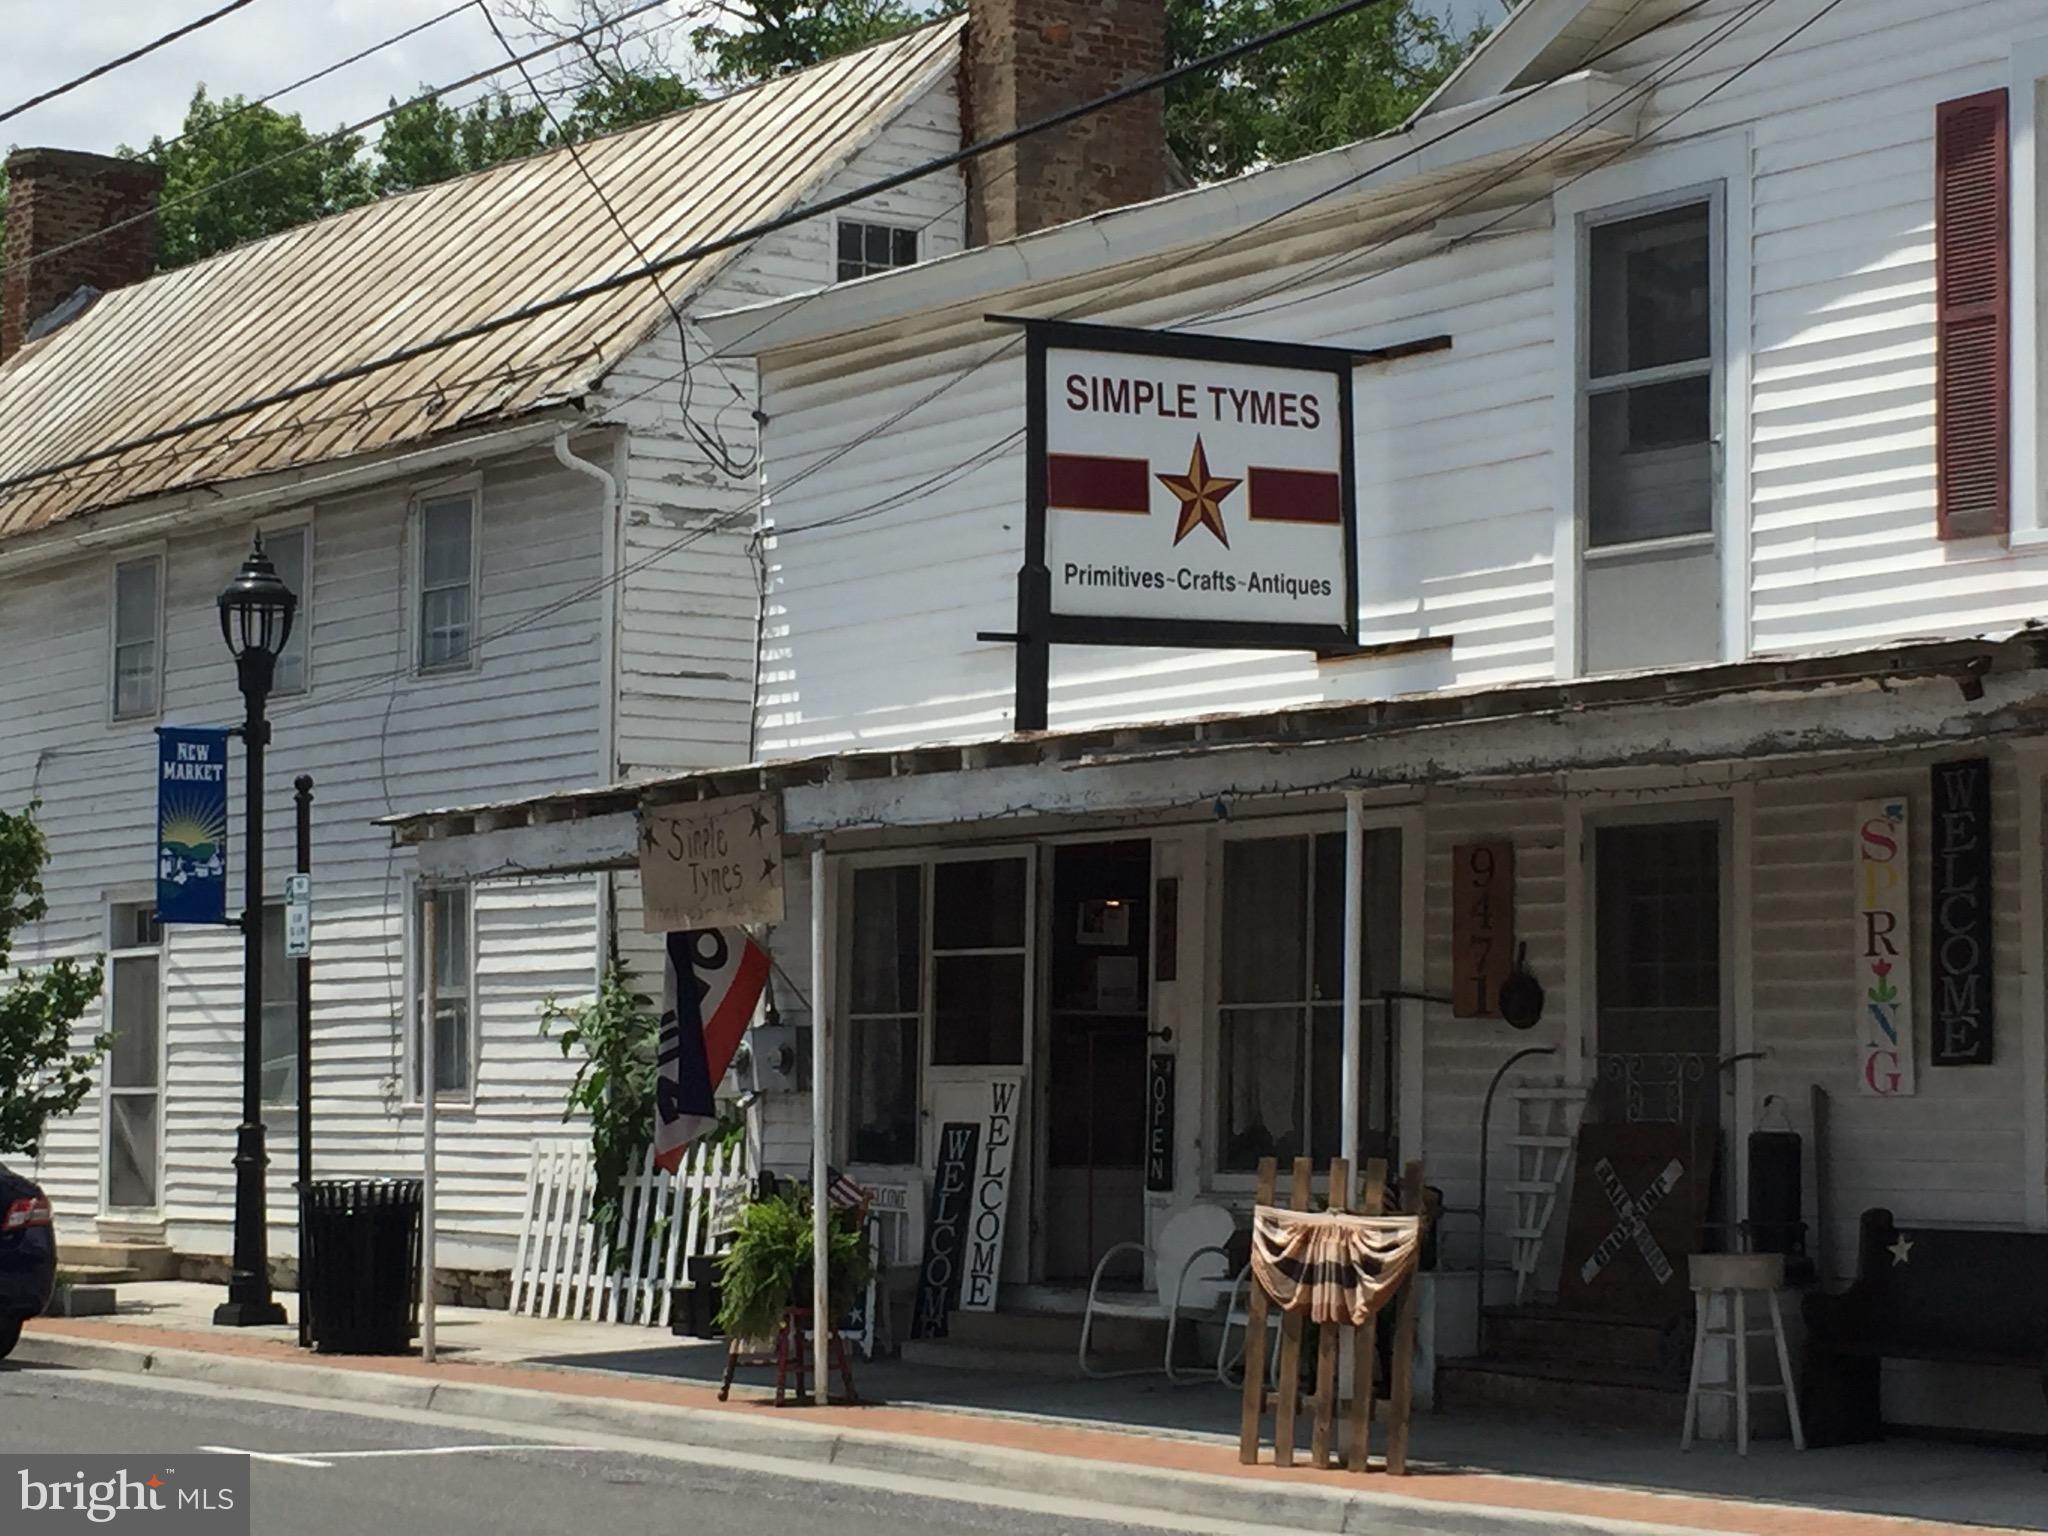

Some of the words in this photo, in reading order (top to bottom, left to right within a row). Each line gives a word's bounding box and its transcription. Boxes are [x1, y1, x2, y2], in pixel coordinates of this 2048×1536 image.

[1066, 374, 1198, 419] SIMPLE
[1207, 386, 1320, 429] TYMES
[163, 761, 224, 782] MARKET
[177, 742, 210, 761] NEW
[1469, 846, 1496, 1016] 9471
[1939, 768, 1981, 1058] WELCOME
[1151, 1075, 1166, 1180] OPEN
[966, 1082, 1016, 1307] WELCOME
